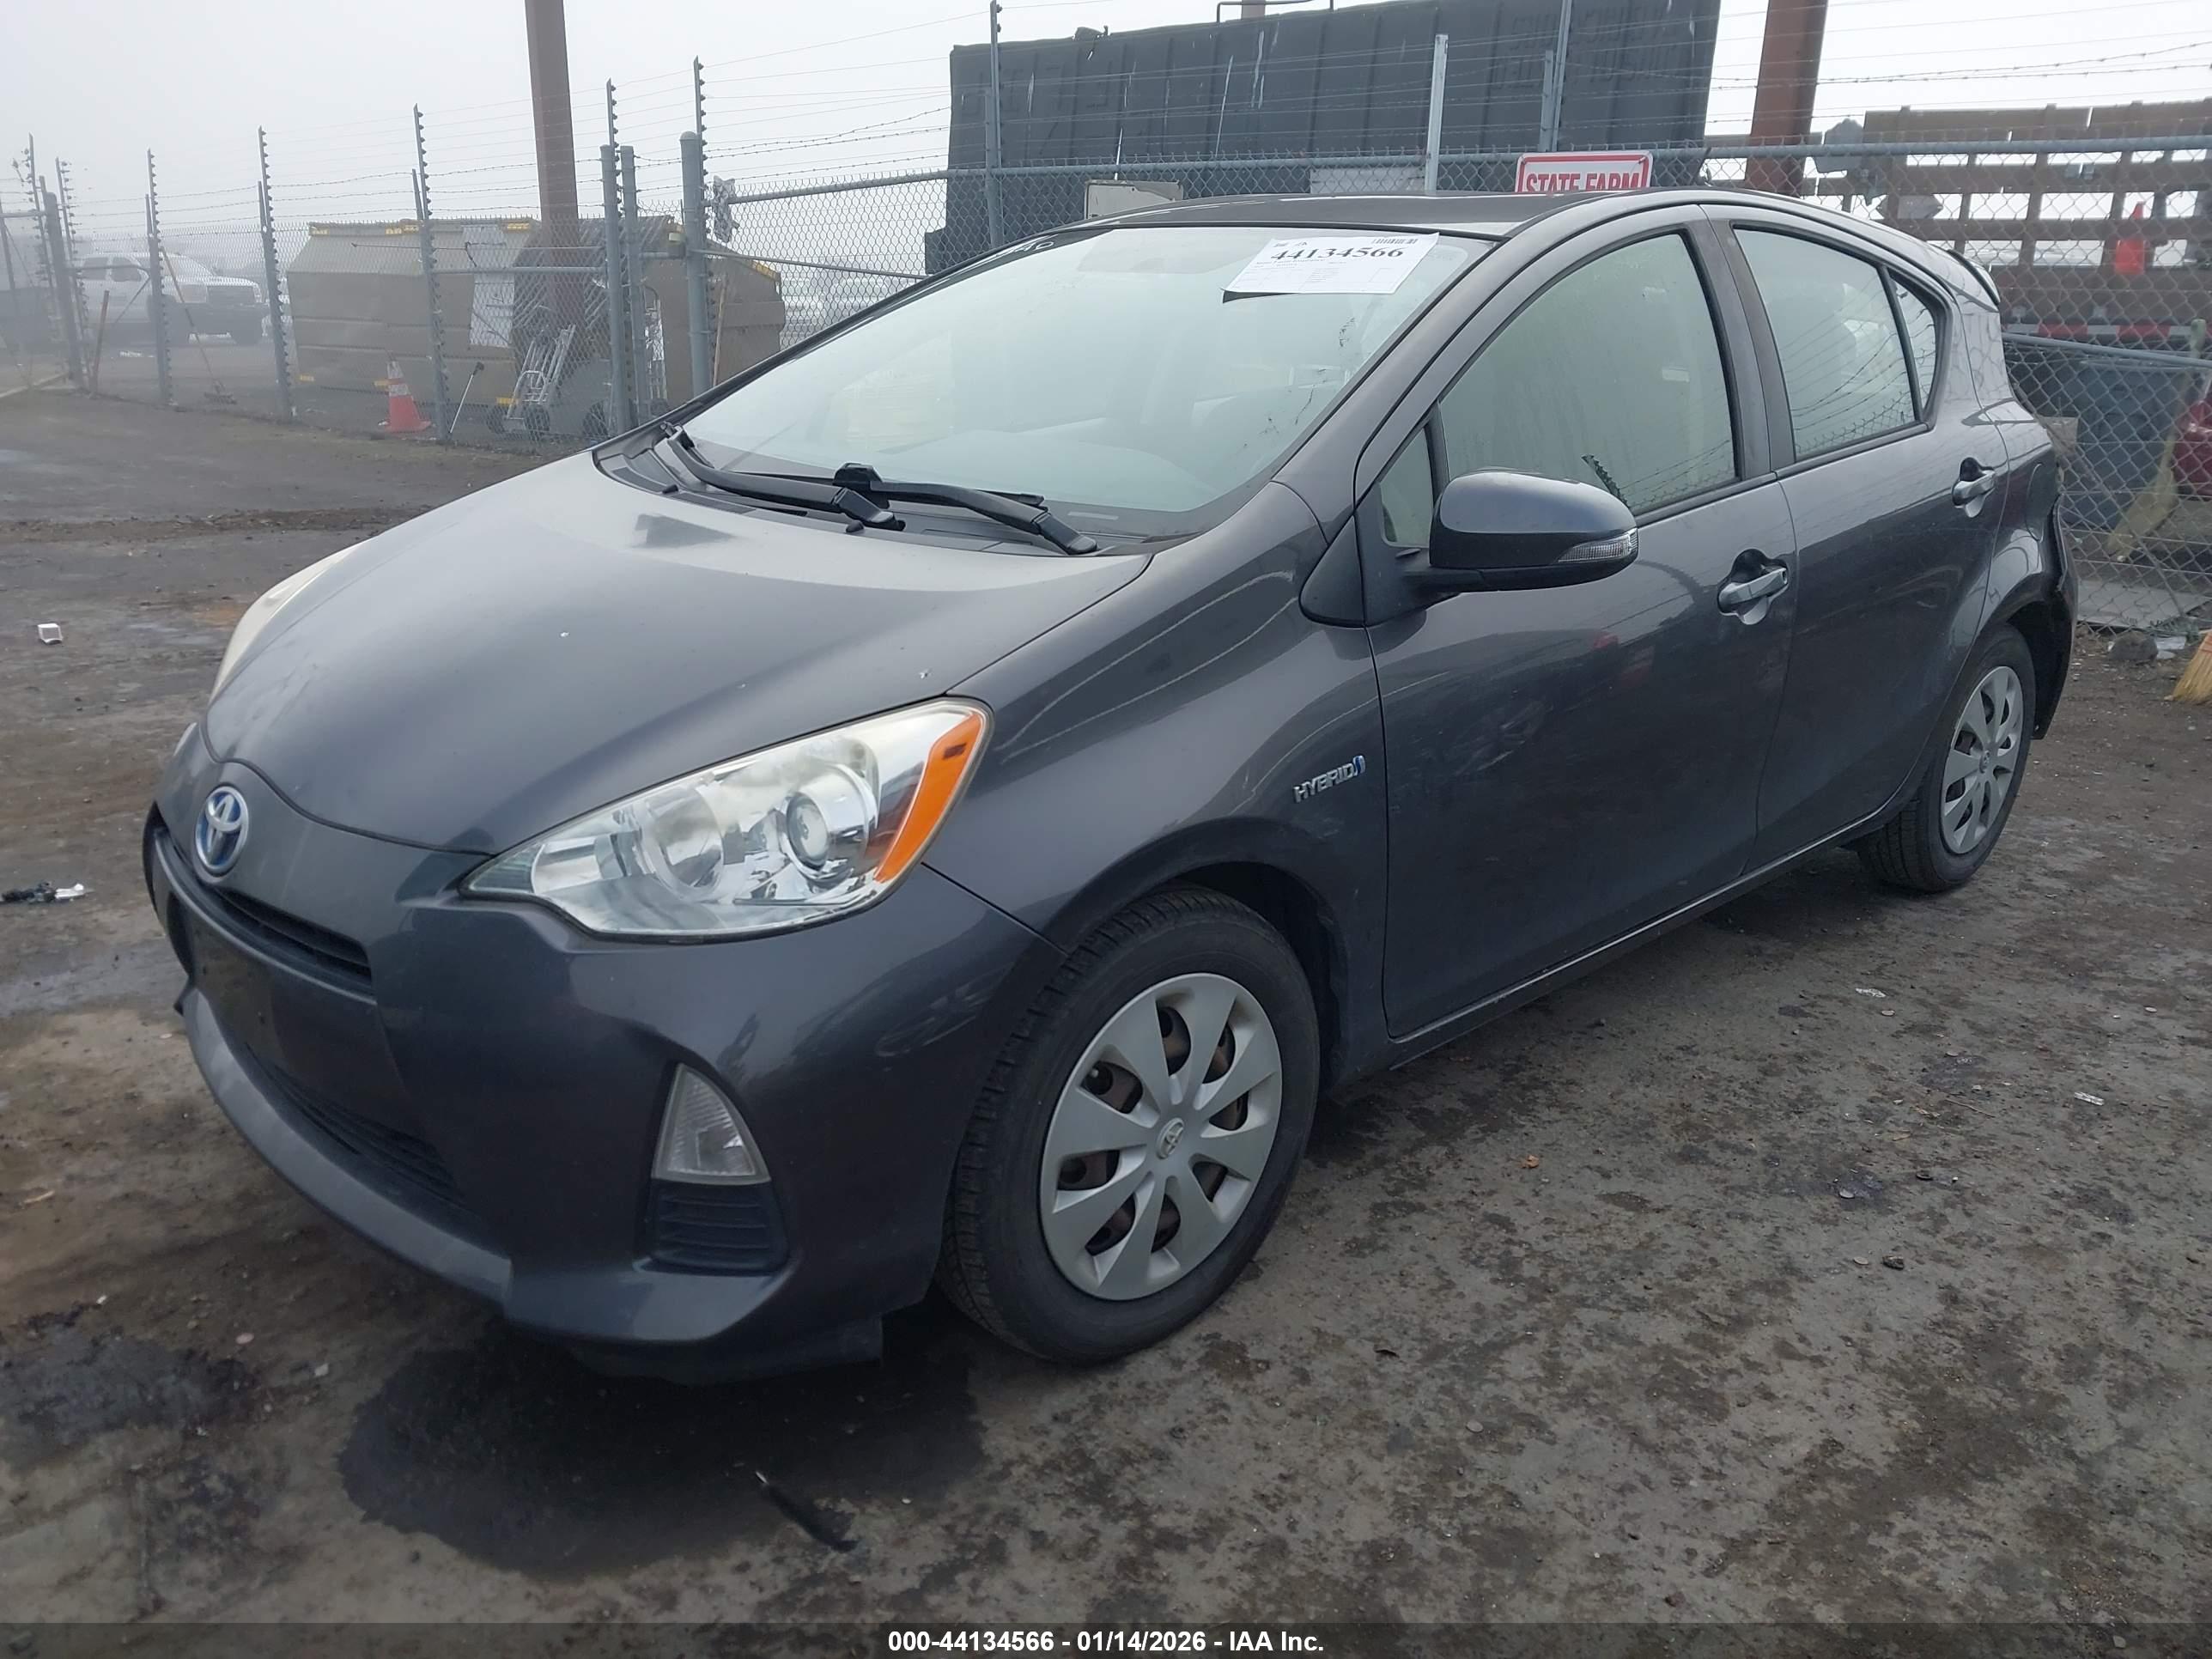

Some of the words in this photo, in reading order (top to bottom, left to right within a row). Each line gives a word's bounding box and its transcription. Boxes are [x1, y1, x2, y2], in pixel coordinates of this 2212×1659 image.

[1526, 173, 1581, 192] STATE
[1585, 172, 1640, 191] FARM
[1271, 246, 1406, 260] 44134566
[1294, 763, 1354, 803] HYBRID
